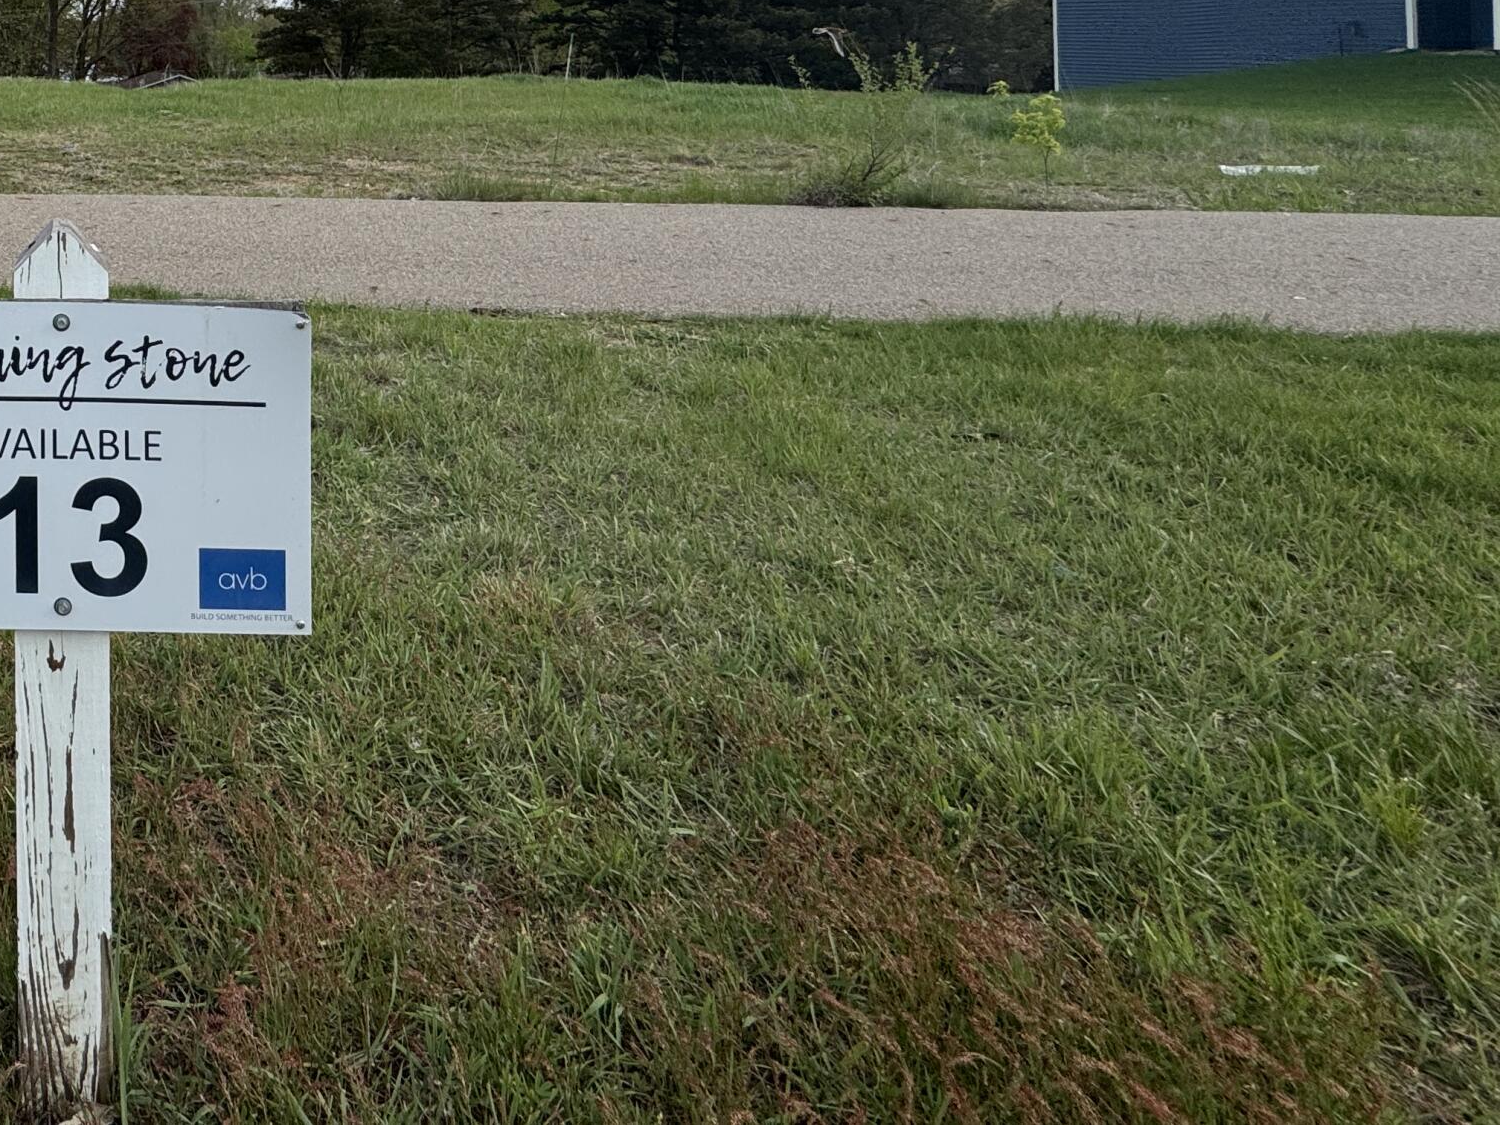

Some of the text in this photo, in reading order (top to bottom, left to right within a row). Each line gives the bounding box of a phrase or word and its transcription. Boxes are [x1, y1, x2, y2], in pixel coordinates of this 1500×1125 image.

[104, 334, 252, 390] stone
[218, 566, 268, 591] avb
[190, 612, 294, 623] BUILD SOMETHING BETTER
